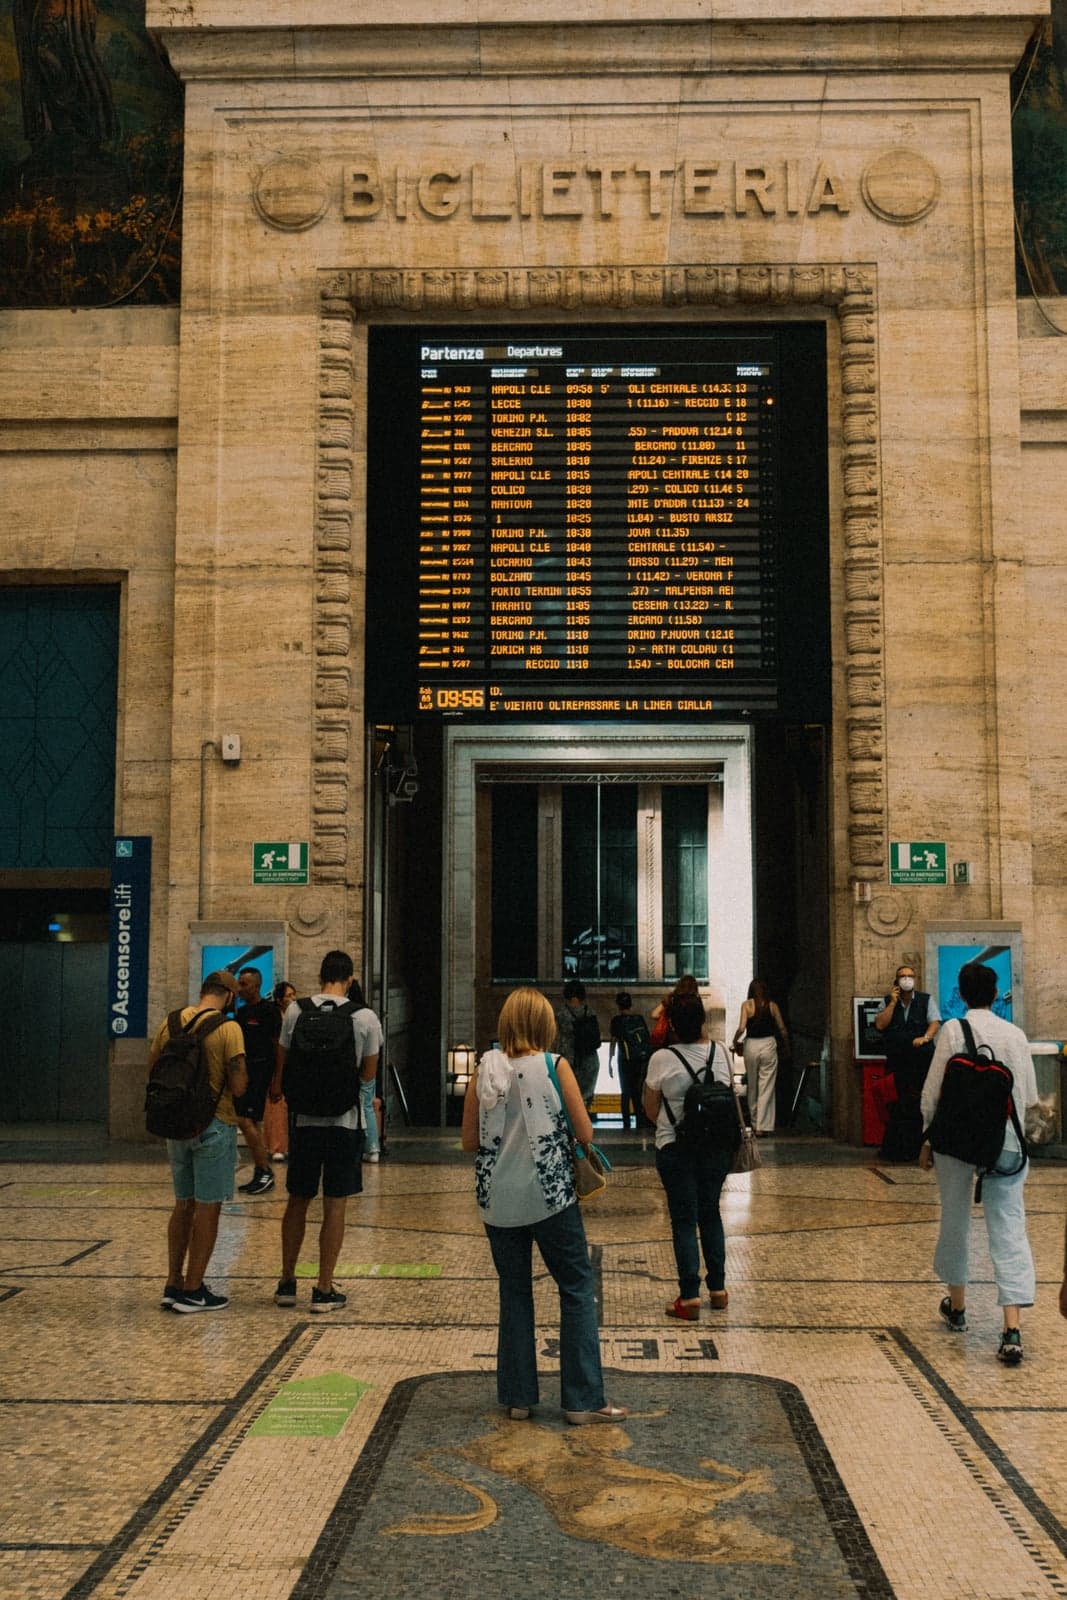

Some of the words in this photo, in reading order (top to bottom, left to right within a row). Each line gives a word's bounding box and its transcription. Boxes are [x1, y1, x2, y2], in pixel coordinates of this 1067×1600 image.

[342, 159, 850, 220] BIGLIETTERIA
[421, 347, 484, 360] Partenze
[507, 346, 563, 358] Departures
[491, 384, 525, 394] NAPOLI
[649, 384, 697, 394] CENTRALE
[735, 384, 746, 394] 13
[491, 398, 521, 409] LECCE
[566, 398, 591, 409] 10:00
[492, 413, 524, 423] TORINO
[566, 413, 591, 423] 10:02
[735, 413, 747, 423] 12
[491, 427, 531, 437] VENEZIA
[566, 427, 591, 437] 10:05
[662, 427, 699, 437] PADOVA
[491, 441, 533, 452] BERGAMO
[566, 441, 591, 452] 10:05
[634, 441, 676, 452] BERGAMO
[735, 441, 745, 452] 11
[491, 455, 533, 466] SALERNO
[566, 455, 590, 466] 10:10
[631, 455, 666, 466] (11.24)
[681, 455, 722, 466] FIRENZE
[735, 455, 747, 466] 17
[490, 470, 525, 480] NAPOLI
[566, 470, 590, 480] 10:15
[661, 470, 710, 480] CENTRALE
[735, 470, 749, 480] 20
[490, 484, 525, 495] COLICO
[565, 484, 591, 495] 10:20
[664, 484, 699, 495] COLICO
[736, 484, 743, 495] 5
[490, 499, 532, 509] MANTOVA
[566, 499, 591, 509] 10:20
[653, 499, 687, 509] D'ADDA
[691, 499, 724, 509] (11.13)
[736, 499, 749, 509] 24
[566, 513, 591, 523] 10:25
[669, 513, 699, 523] BUSTO
[704, 513, 733, 523] ARSIZ
[491, 528, 524, 538] TORINO
[566, 528, 591, 538] 10:30
[655, 528, 689, 538] (11.35)
[490, 542, 524, 553] NAPOLI
[566, 542, 591, 553] 10:40
[628, 542, 675, 553] CENTRALE
[680, 542, 714, 553] (11.54)
[490, 557, 532, 567] LOCARNO
[566, 557, 591, 567] 10:43
[664, 557, 698, 567] (11.29)
[490, 571, 532, 582] BOLZANO
[566, 571, 591, 582] 10:45
[636, 571, 670, 582] (11.42)
[686, 571, 722, 582] VERONA
[491, 586, 520, 596] PORTO
[566, 586, 591, 596] 10:55
[665, 586, 713, 596] MALPENSA
[491, 600, 531, 611] TARANTO
[566, 600, 590, 611] 11:05
[631, 600, 668, 611] CESENA
[673, 600, 709, 611] (13.22)
[490, 615, 532, 625] BERGAMO
[566, 615, 590, 625] 11:05
[491, 630, 524, 640] TORINO
[566, 630, 588, 640] 11:10
[490, 644, 524, 655] ZURICH
[529, 644, 542, 655] HB
[566, 644, 588, 655] 11:10
[651, 644, 675, 655] ARTH
[566, 659, 588, 669] 11:10
[667, 659, 710, 669] BOLOGNA
[437, 690, 484, 708] 09:56
[504, 700, 544, 711] VIETATO
[549, 700, 621, 711] OLTREPASSARE
[626, 700, 639, 711] LA
[643, 700, 673, 711] LINEA
